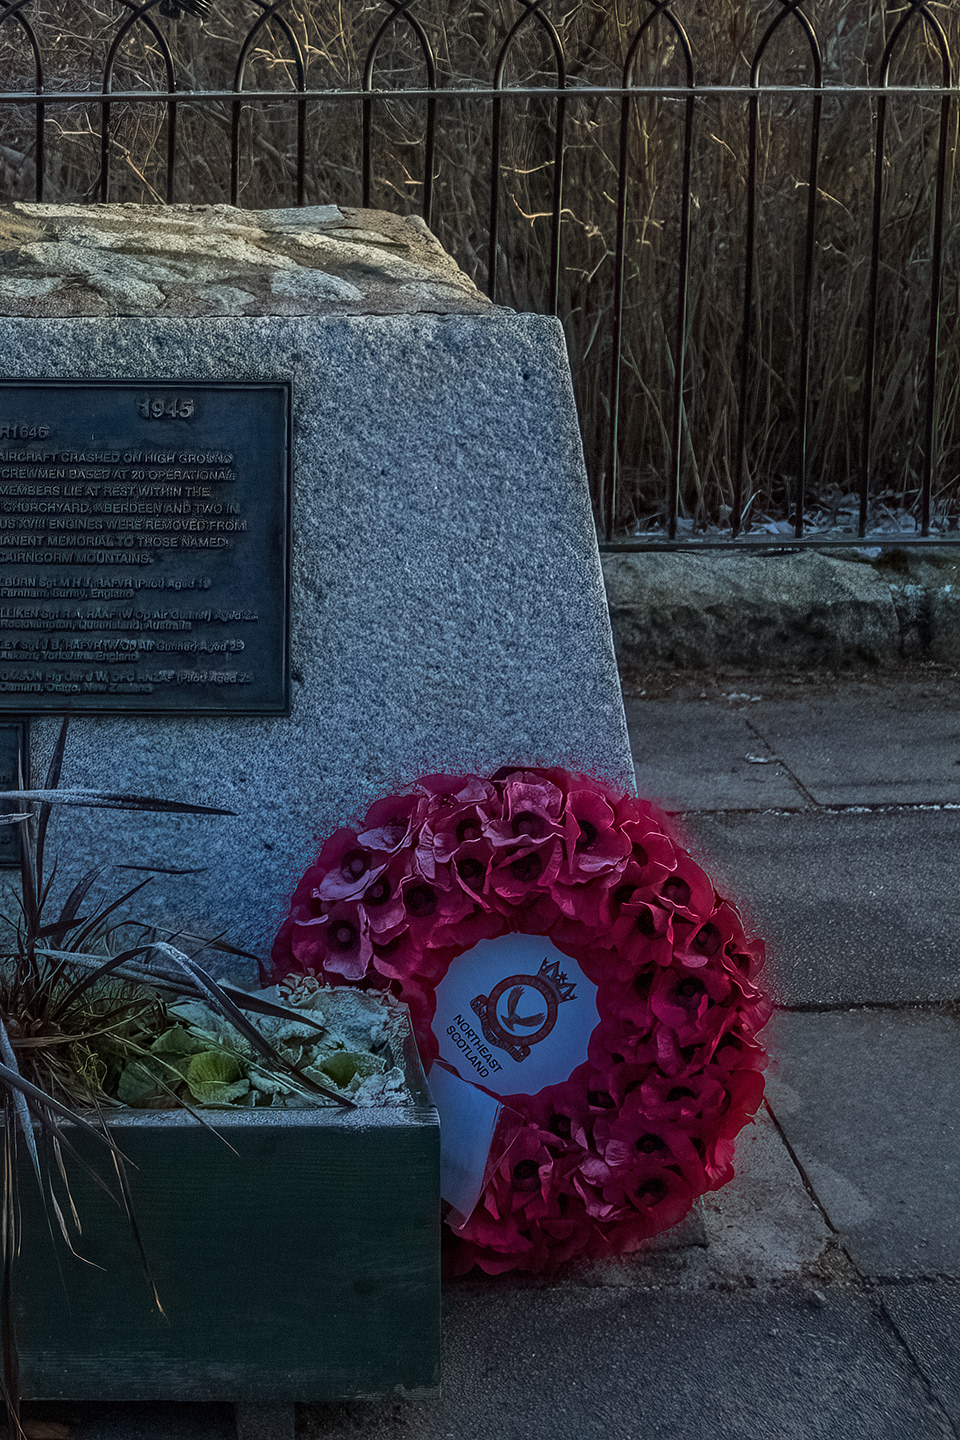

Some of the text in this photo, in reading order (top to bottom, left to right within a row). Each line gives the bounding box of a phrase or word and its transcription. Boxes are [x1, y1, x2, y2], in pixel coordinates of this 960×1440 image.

[138, 395, 195, 418] 1945
[61, 451, 119, 463] CRASHED
[124, 452, 140, 463] ON
[145, 452, 174, 463] HIGH
[179, 452, 234, 464] GROUND
[1, 466, 65, 479] CREWMEN
[68, 467, 111, 479] BASED
[113, 468, 129, 479] AT
[132, 468, 145, 480] 20
[63, 484, 82, 495] LIE
[85, 484, 99, 496] AT
[103, 484, 136, 496] REST
[138, 484, 181, 496] WITHIN
[185, 485, 209, 497] THE
[163, 502, 190, 513] AND
[195, 502, 222, 514] TWO
[226, 503, 239, 514] IN
[49, 518, 103, 529] ENGINES
[107, 518, 142, 530] WERE
[146, 519, 205, 530] REMOVED
[209, 520, 247, 531] FROM
[47, 534, 115, 546] MEMORIAL
[118, 535, 134, 546] TO
[139, 535, 178, 546] THOSE
[453, 1014, 503, 1073] NORTHEAST
[446, 1025, 489, 1078] SCOTLAND
